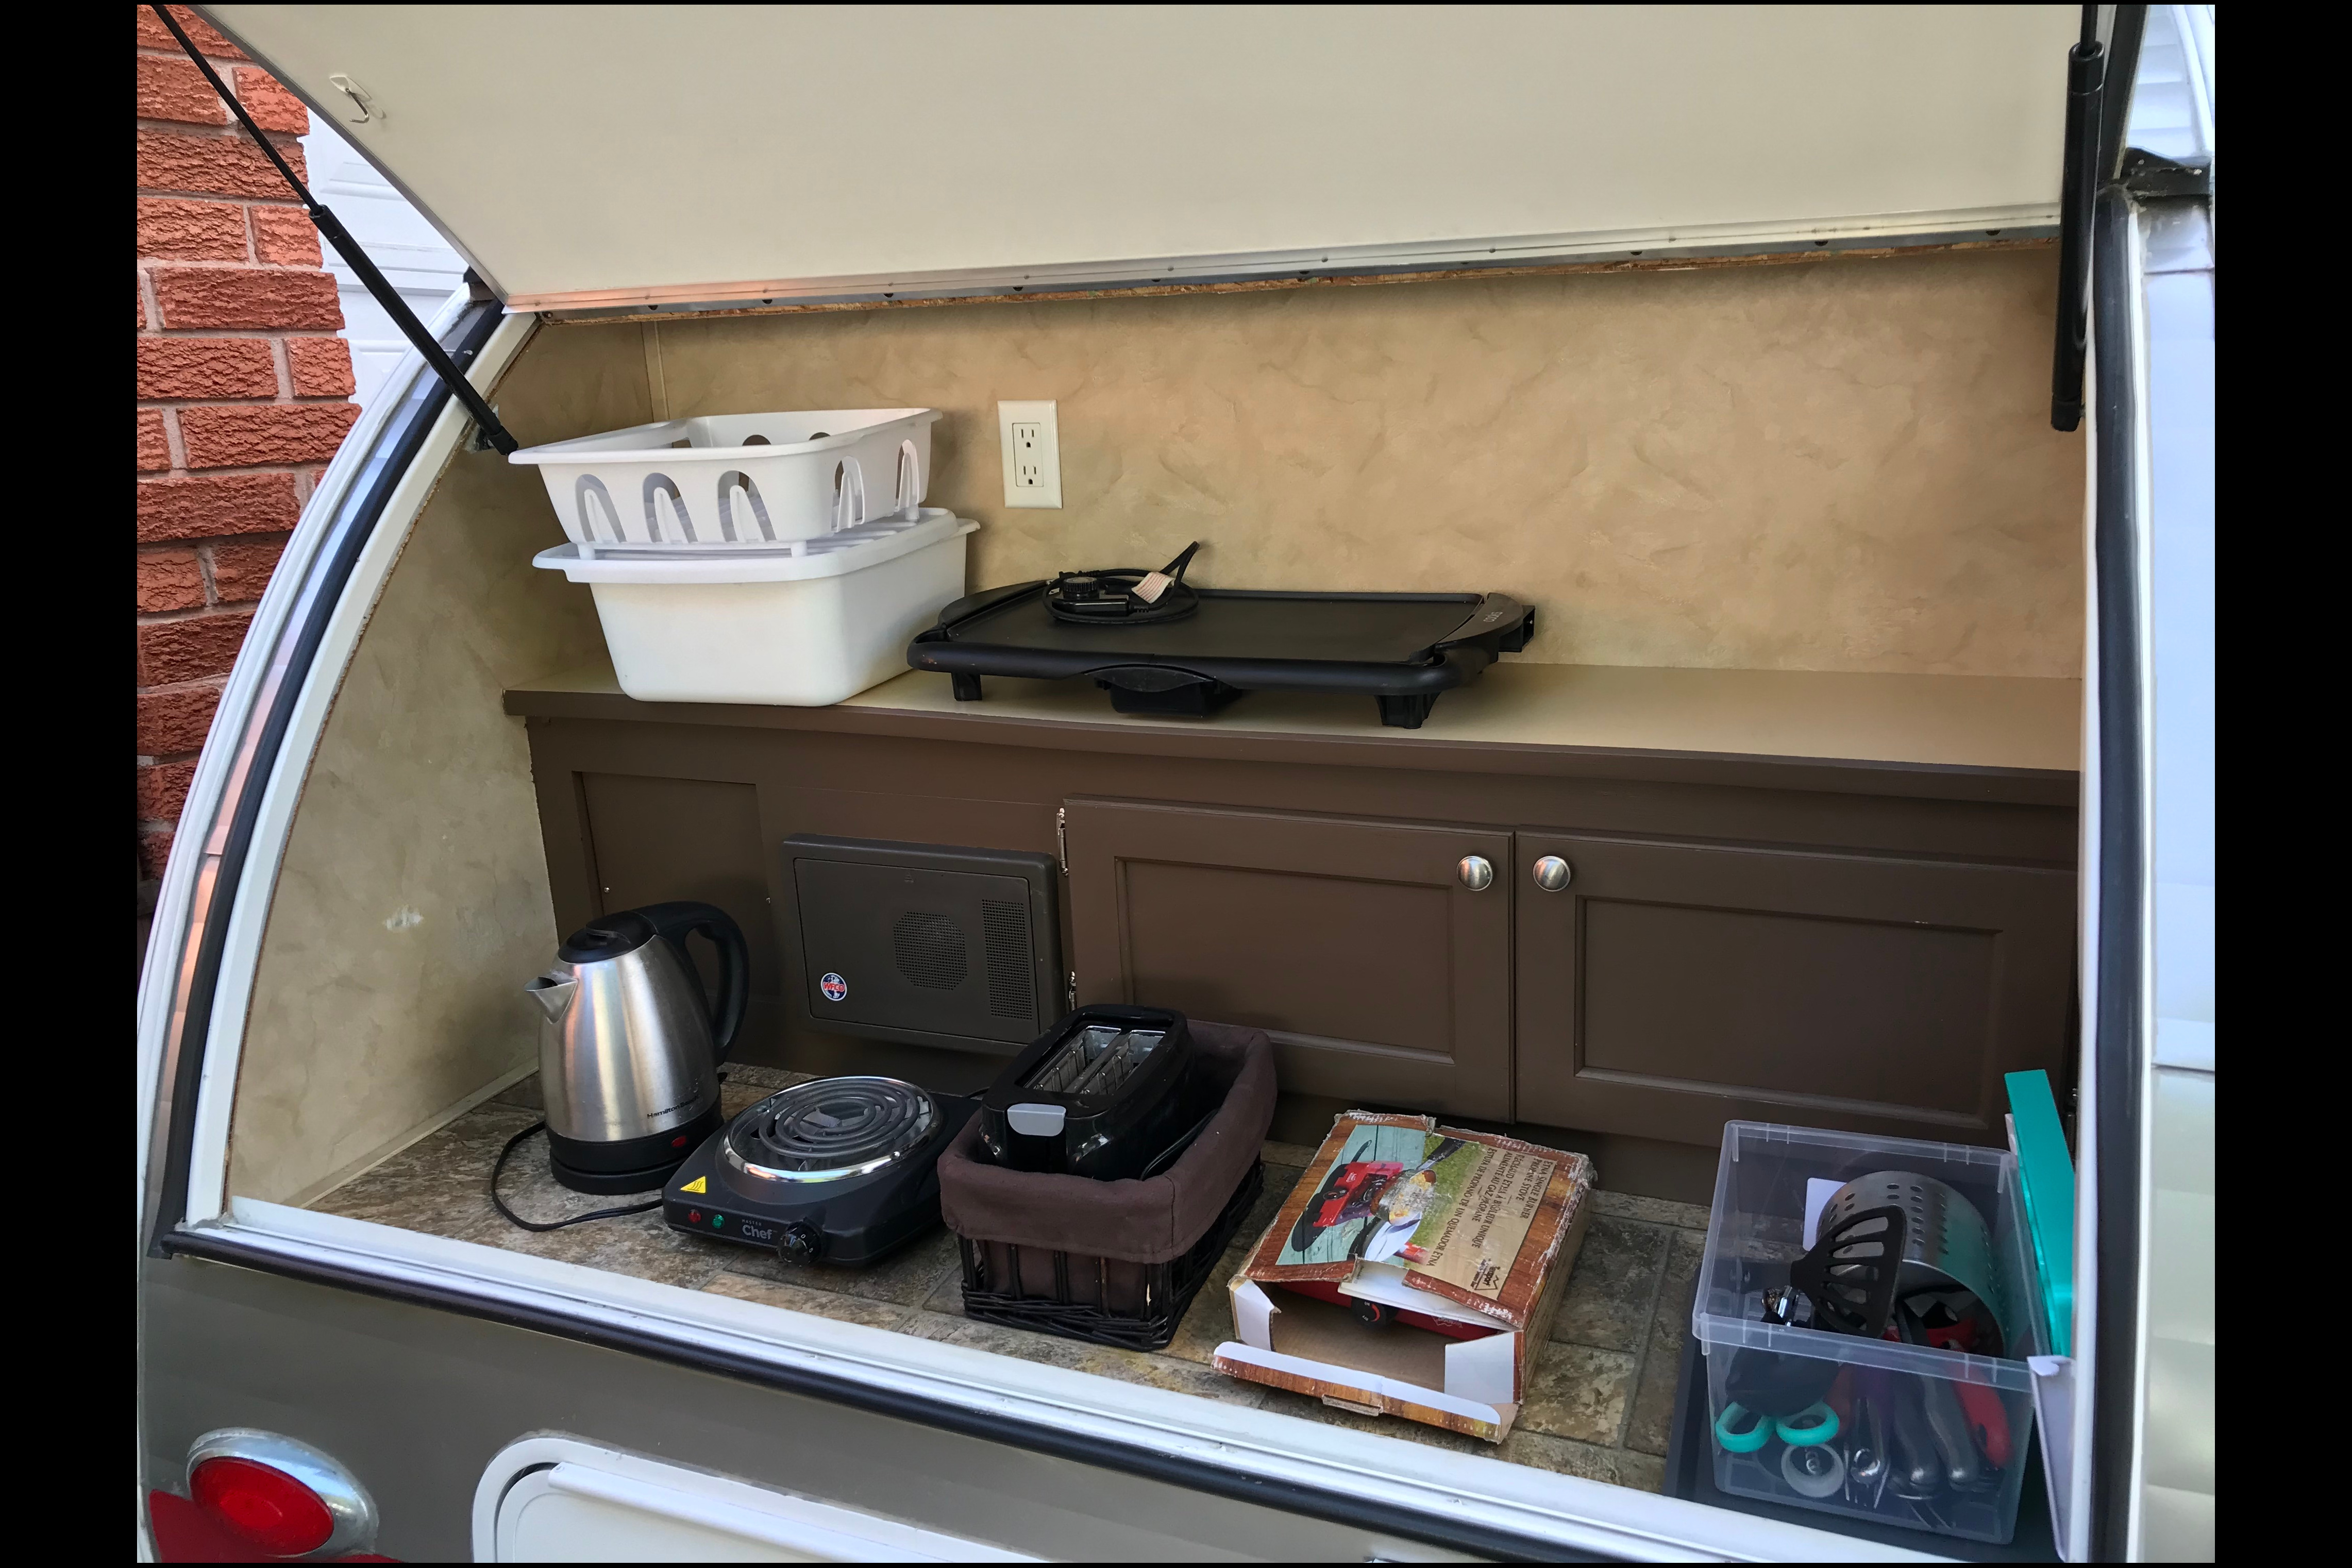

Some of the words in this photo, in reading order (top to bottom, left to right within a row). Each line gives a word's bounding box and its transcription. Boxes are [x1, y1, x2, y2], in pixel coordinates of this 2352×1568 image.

[824, 982, 845, 991] WFCO
[647, 1105, 680, 1118] Hamilton
[1490, 1175, 1501, 1184] AU
[1530, 1175, 1547, 1196] SINGLE
[1484, 1184, 1497, 1196] GAZ
[1516, 1183, 1532, 1201] STOVE
[1458, 1199, 1470, 1207] DE
[1520, 1196, 1537, 1219] BURNER
[1453, 1207, 1465, 1217] UN
[742, 1224, 772, 1240] Chef
[1435, 1218, 1460, 1251] QUEMADOR
[1472, 1224, 1490, 1248] UNIQUE
